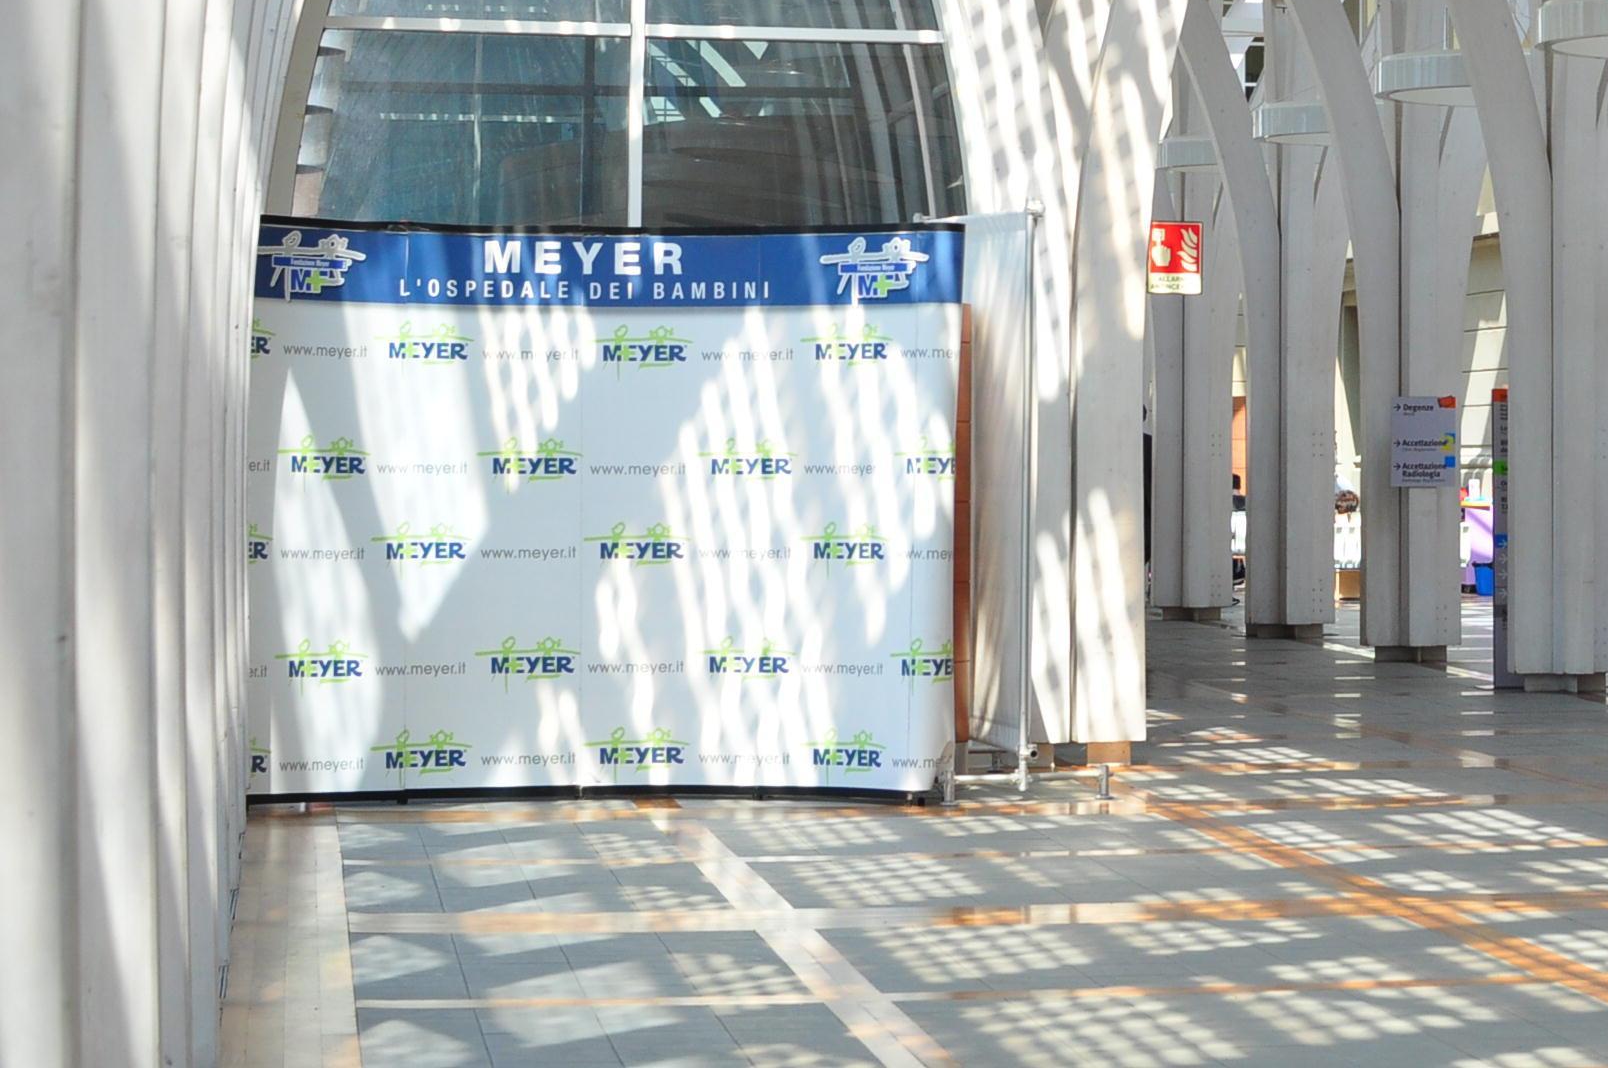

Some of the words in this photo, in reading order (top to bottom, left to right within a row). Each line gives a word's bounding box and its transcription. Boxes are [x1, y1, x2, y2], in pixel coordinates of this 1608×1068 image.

[484, 239, 684, 276] MEYER
[400, 278, 570, 298] L'OSPEDALE
[589, 280, 633, 300] DEI
[653, 280, 770, 300] BAMBINI
[283, 342, 368, 360] www.meyer.it
[388, 341, 469, 360] MEYER
[602, 343, 687, 363] MEYER
[815, 342, 888, 361] MEYER
[1402, 404, 1434, 412] Degenze
[1402, 439, 1447, 447] Accettazione
[291, 455, 366, 476] MEYER
[492, 456, 577, 476] MEYER
[590, 461, 686, 479] www.meyer.it
[711, 457, 792, 476] MEYER
[1402, 470, 1441, 479] Radiologia
[280, 546, 365, 561] www.meyer.it
[386, 541, 466, 561] MEYER
[480, 544, 577, 562] www.meyer.it
[600, 541, 684, 560] MEYER
[813, 541, 885, 561] MEYER
[288, 659, 363, 679] MEYER
[375, 662, 467, 678] www.meyer.it
[491, 655, 575, 675] MEYER
[587, 660, 685, 677] www.meyer.it
[709, 656, 790, 675] MEYER
[279, 757, 364, 774] www.meyer.it
[385, 749, 467, 770] MEYER
[480, 752, 576, 768] www.meyer.it
[600, 746, 685, 765] MEYER
[813, 748, 882, 769] MEYER
